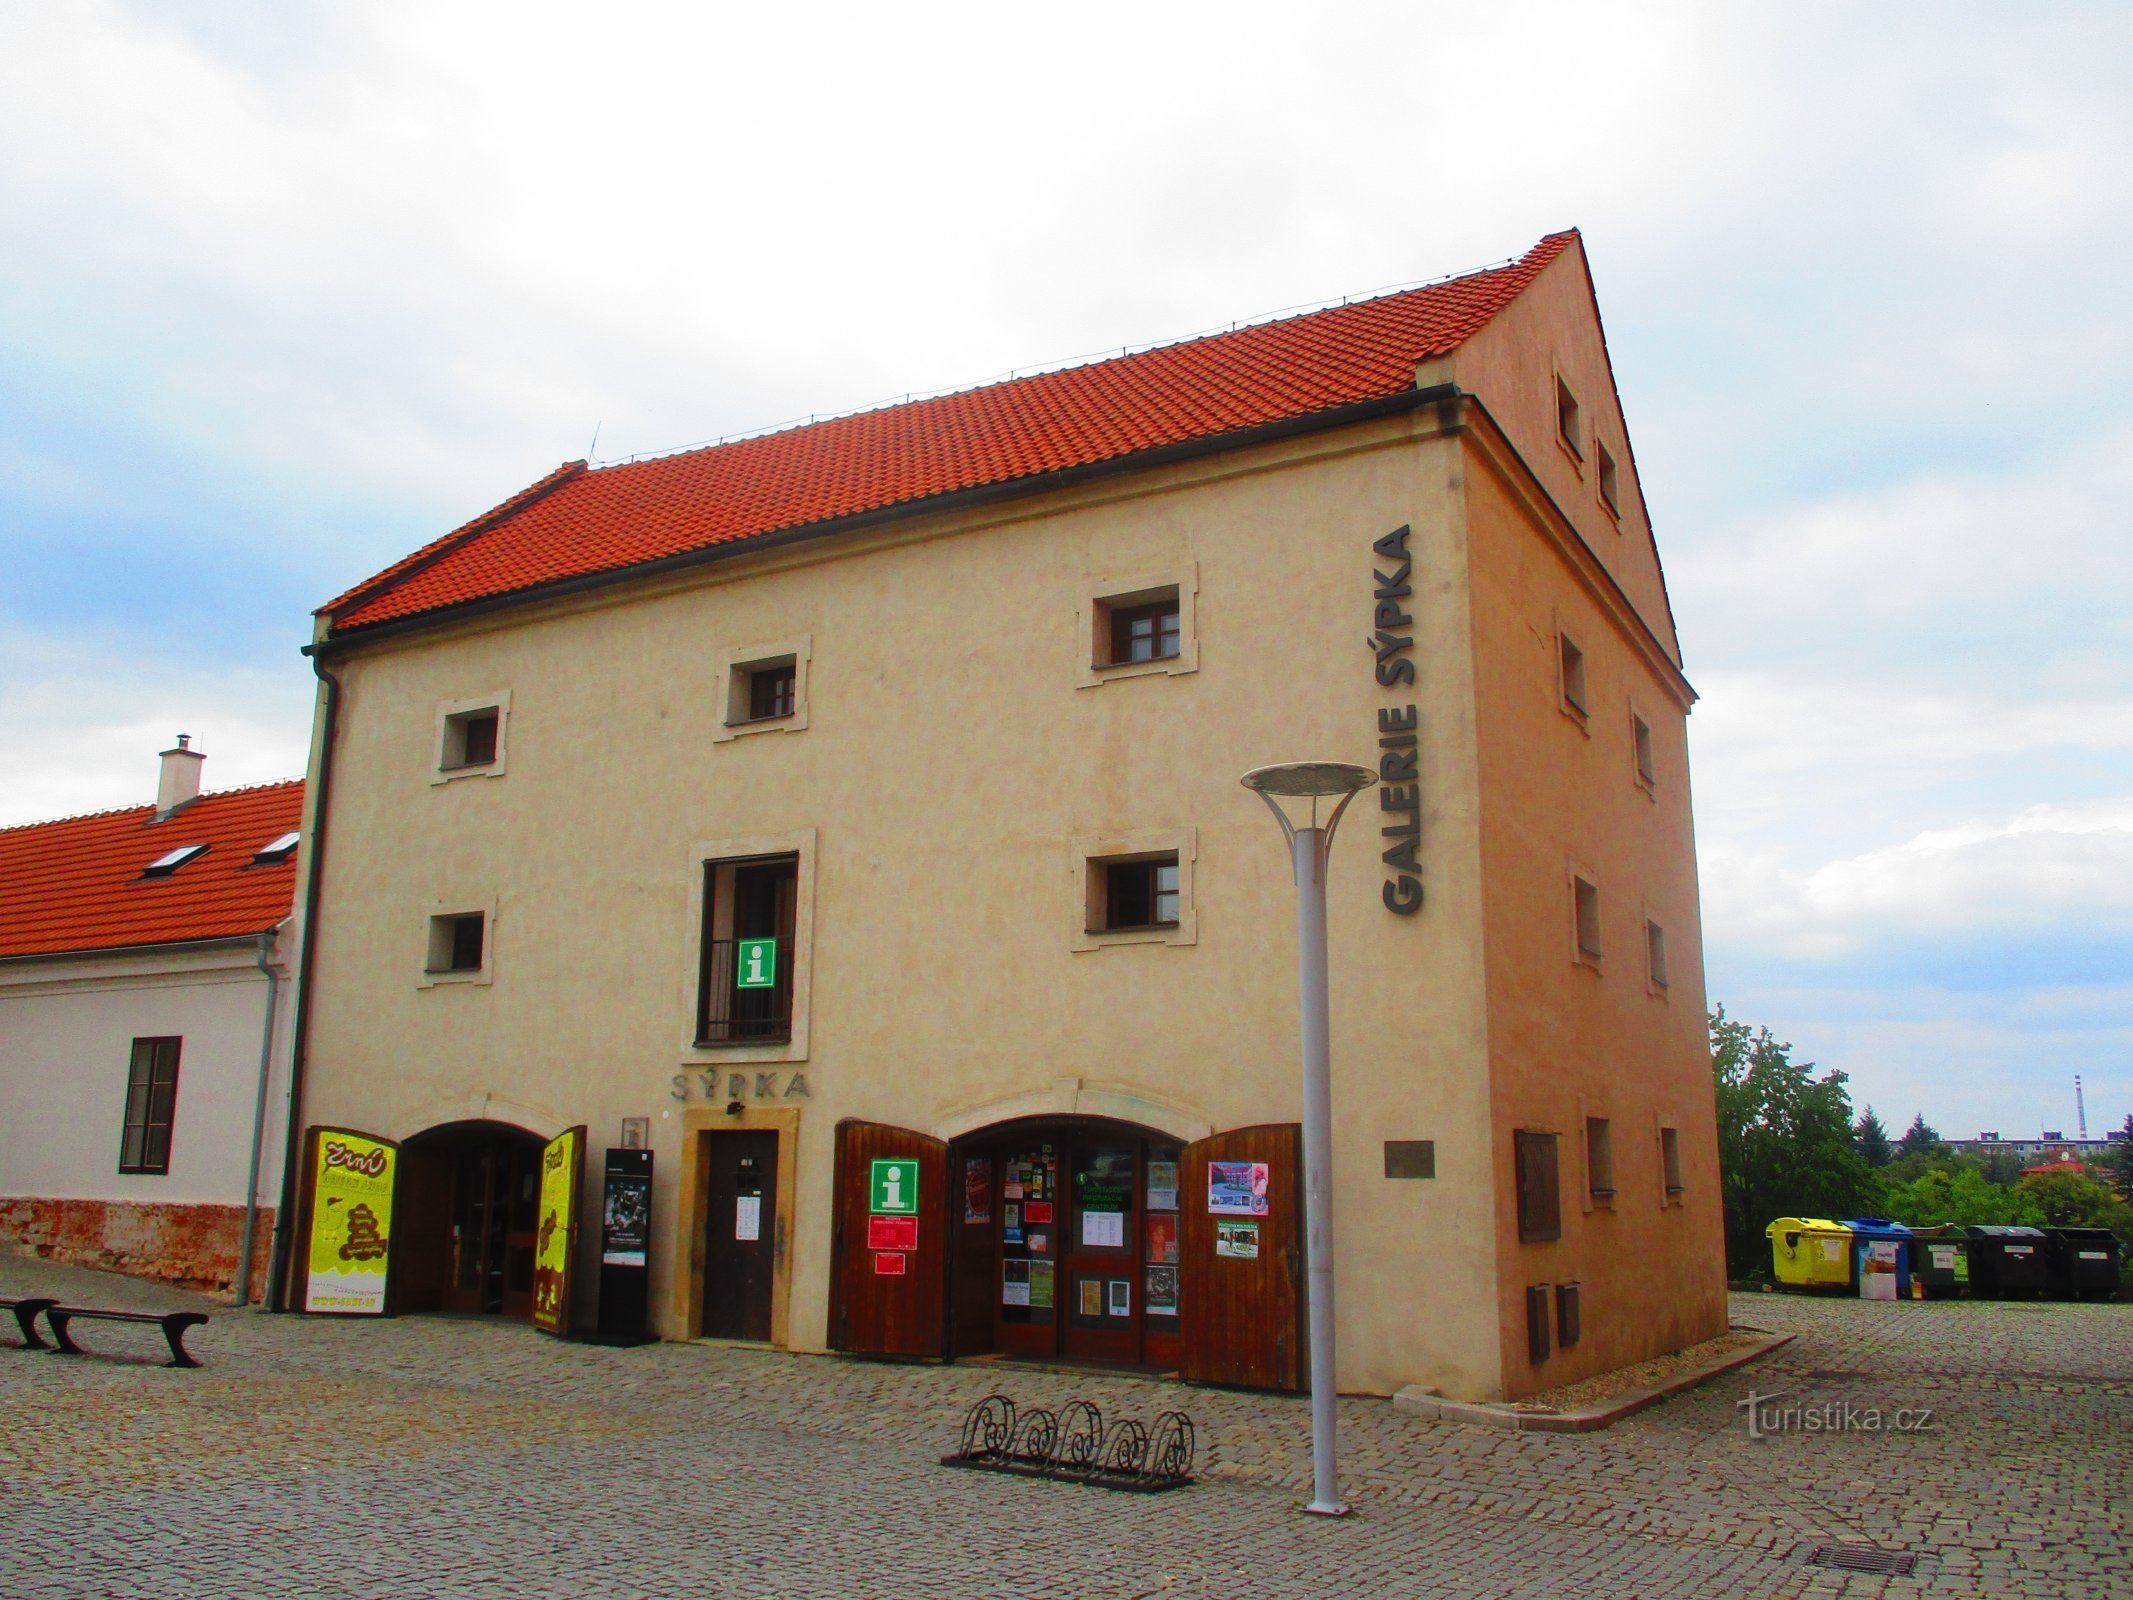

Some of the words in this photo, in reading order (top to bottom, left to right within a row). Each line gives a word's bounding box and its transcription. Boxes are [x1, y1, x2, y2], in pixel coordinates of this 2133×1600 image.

[1367, 524, 1414, 687] SÝPKA
[1378, 704, 1422, 915] GALERIE
[671, 1066, 809, 1101] SÝPKA
